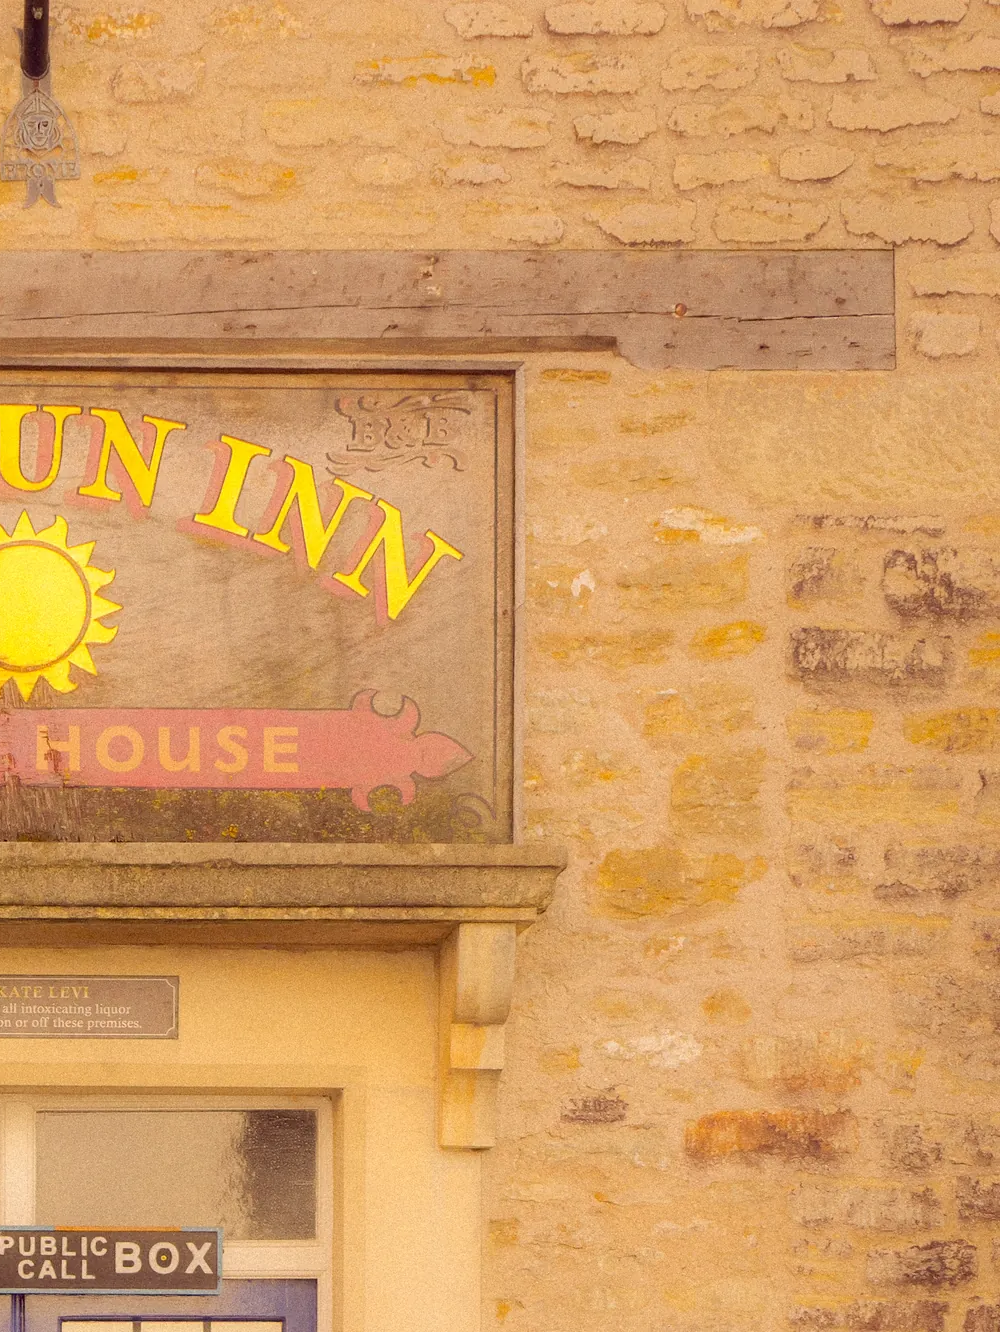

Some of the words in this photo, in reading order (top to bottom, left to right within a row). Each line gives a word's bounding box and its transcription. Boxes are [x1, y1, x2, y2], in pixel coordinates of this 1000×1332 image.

[190, 434, 465, 622] INN
[35, 724, 301, 774] HOUSE
[48, 986, 90, 999] LEVI
[2, 1002, 17, 1014] all
[21, 1003, 93, 1017] intoxicating
[95, 1003, 132, 1018] liquor
[15, 1018, 29, 1028] or
[31, 1016, 50, 1028] off
[53, 1016, 84, 1028] these
[87, 1018, 142, 1031] premises.
[0, 1235, 108, 1257] PUBLIC
[115, 1241, 214, 1275] BOX
[17, 1259, 97, 1281] CALL
